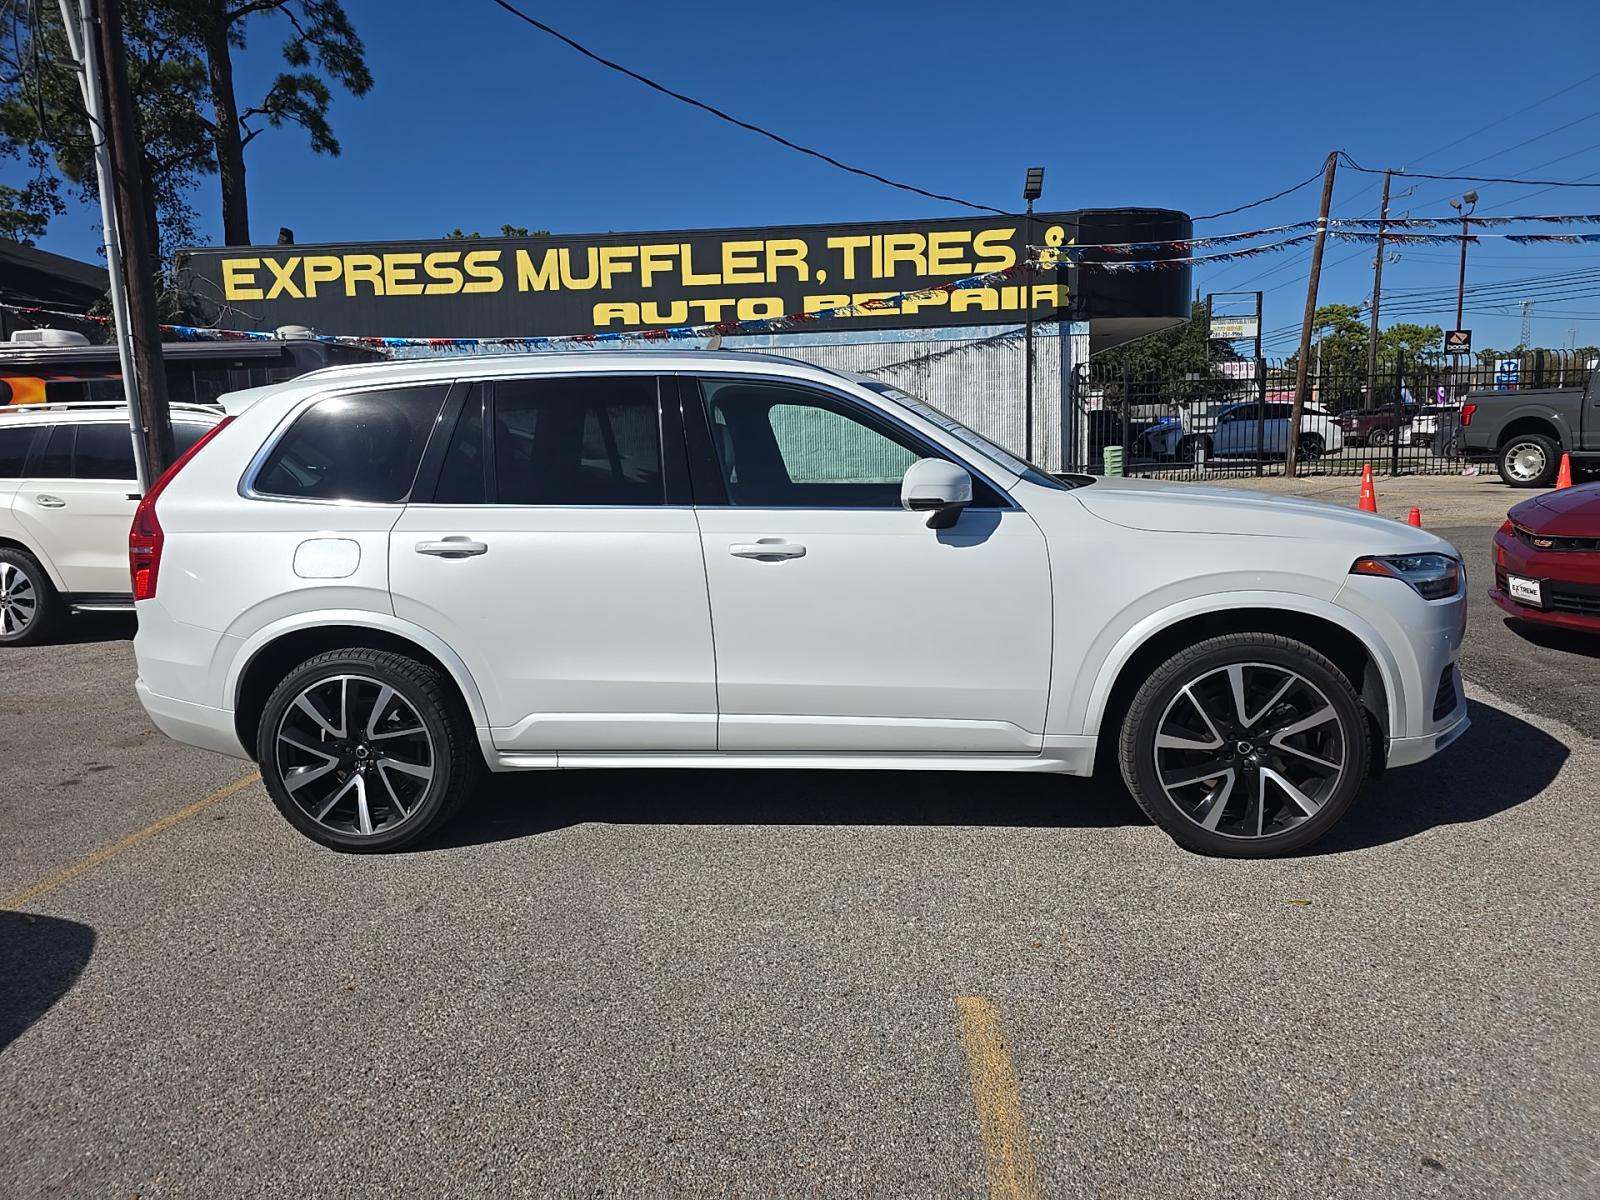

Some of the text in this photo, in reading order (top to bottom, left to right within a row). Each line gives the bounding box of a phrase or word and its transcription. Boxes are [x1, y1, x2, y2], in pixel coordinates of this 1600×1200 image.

[221, 250, 504, 301] EXPRESS
[827, 228, 1017, 280] TIRES
[592, 284, 1070, 326] AUTO REPAIR
